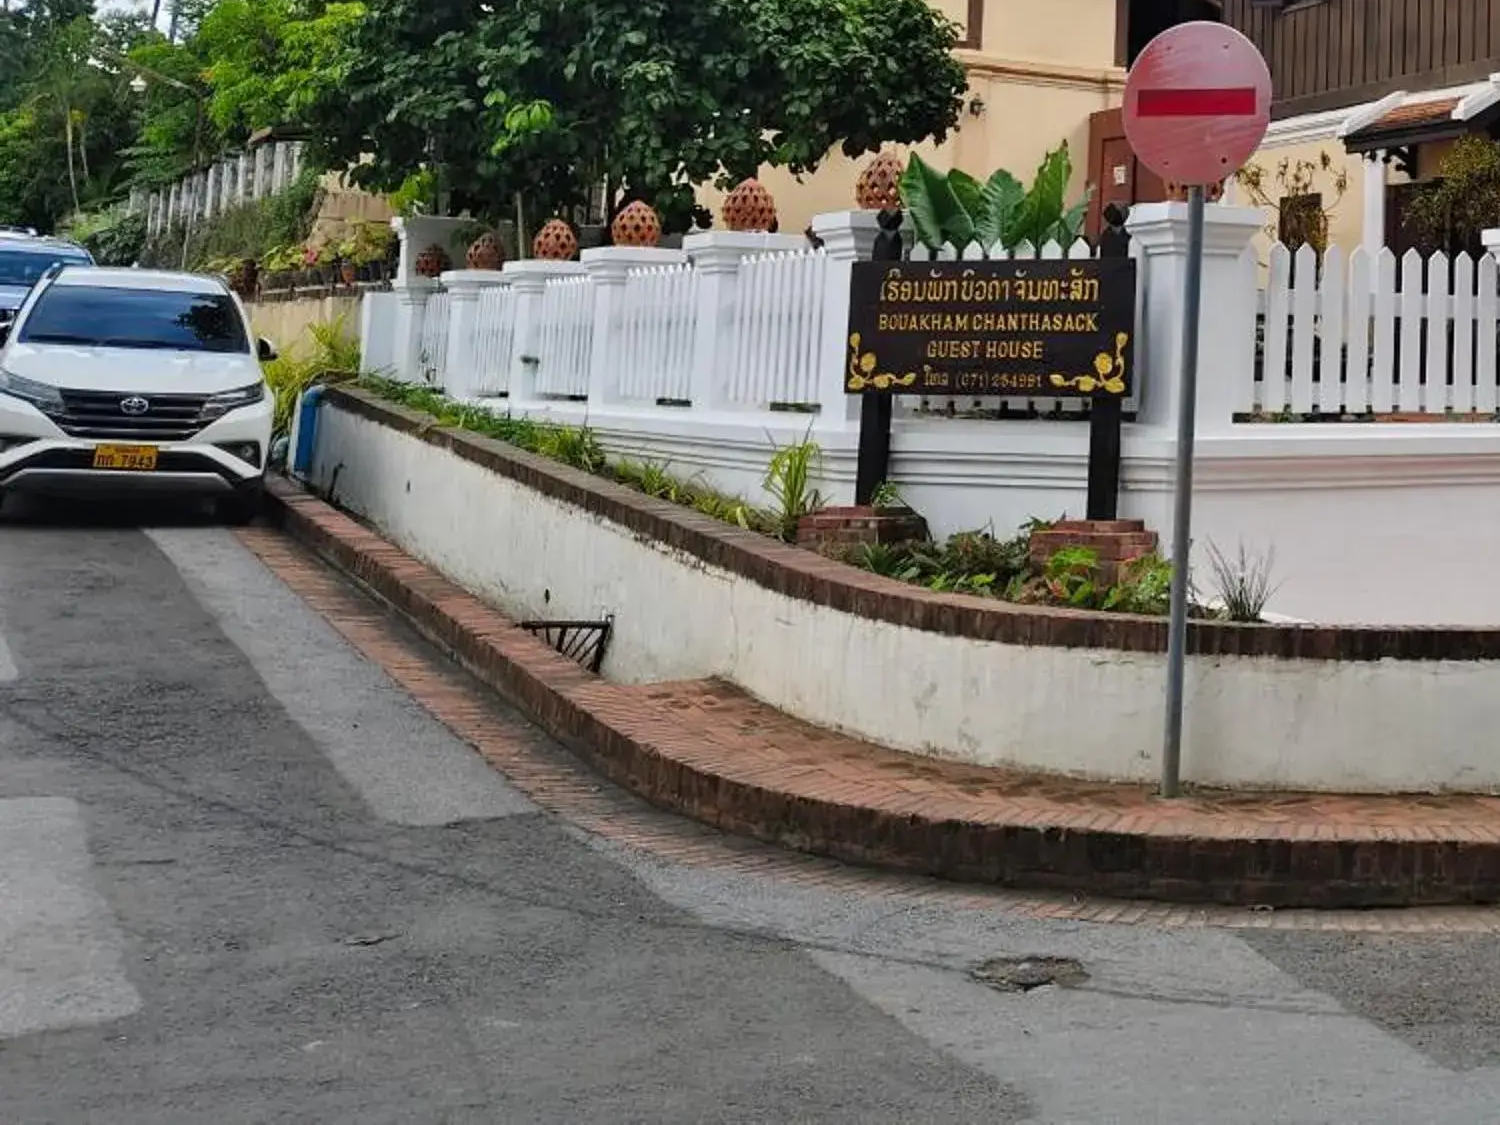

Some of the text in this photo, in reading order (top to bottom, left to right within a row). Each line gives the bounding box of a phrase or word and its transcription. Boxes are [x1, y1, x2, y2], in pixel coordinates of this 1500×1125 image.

[879, 313, 1099, 331] BOUAKHAM CHANTHASACK
[927, 340, 1044, 358] GUEST HOUSE
